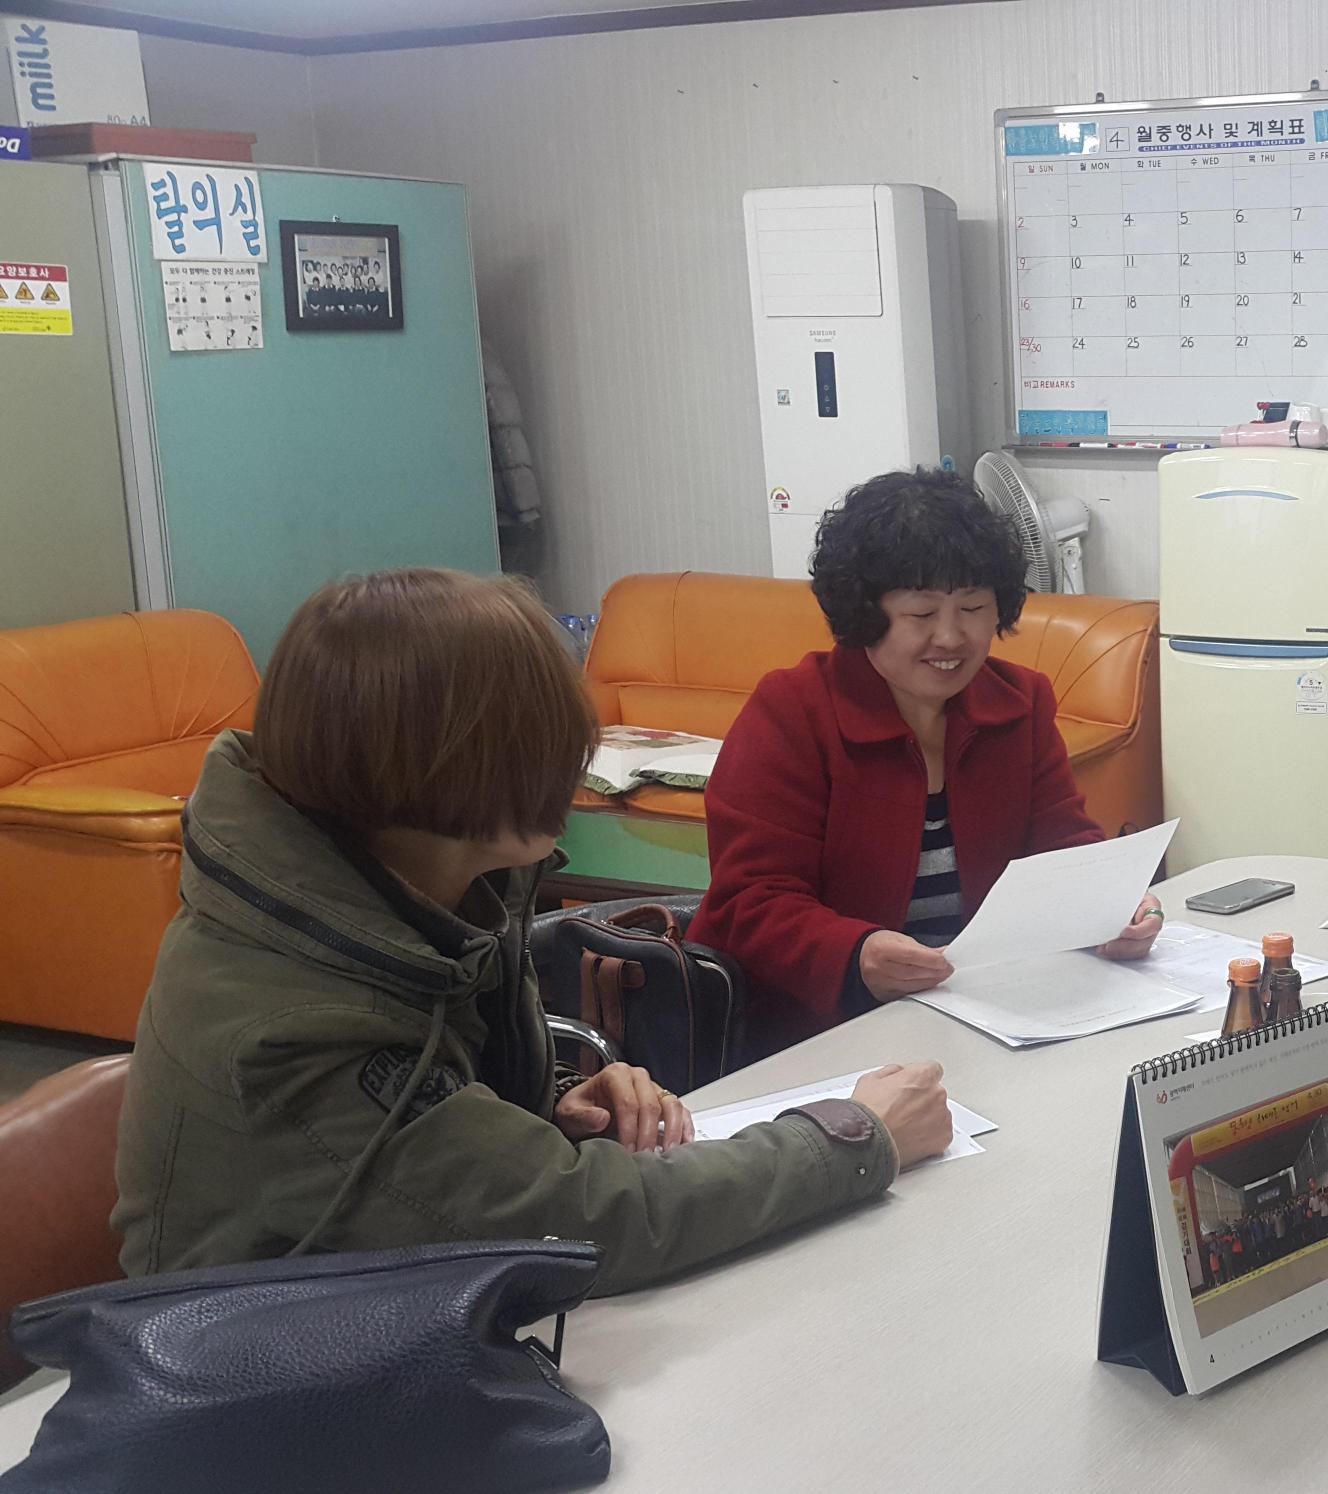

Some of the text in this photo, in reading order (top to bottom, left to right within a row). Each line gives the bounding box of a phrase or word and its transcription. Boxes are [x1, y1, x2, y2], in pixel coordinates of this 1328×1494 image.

[15, 23, 56, 111] miilk
[1109, 131, 1124, 149] 4
[1136, 122, 1214, 142] 월중행사
[1224, 122, 1238, 138] 및
[1247, 118, 1305, 138] 계획표
[1260, 138, 1302, 146] MONTH
[1028, 165, 1035, 173] 일
[1080, 162, 1086, 171] 월
[1091, 162, 1110, 170] MON
[1137, 160, 1144, 168] 화
[1149, 160, 1162, 168] TUE
[1191, 158, 1198, 166] 수
[1202, 157, 1220, 165] WED
[1249, 154, 1256, 162] 목
[1261, 154, 1275, 162] THU
[1308, 152, 1316, 160] 금
[150, 170, 261, 256] 탈의실
[1018, 217, 1025, 229] 2
[1071, 216, 1078, 228] 3
[1124, 214, 1134, 226] 4
[1180, 212, 1189, 225] 5
[1236, 209, 1244, 222] 6
[1294, 208, 1302, 221] 7
[1020, 258, 1026, 270] 9
[1072, 257, 1082, 269] 10
[1126, 256, 1134, 266] 11
[1180, 254, 1190, 266] 12
[1236, 252, 1246, 264] 13
[1294, 251, 1304, 263] 14
[1020, 299, 1030, 310] 16
[1072, 298, 1082, 309] 17
[1127, 296, 1137, 308] 18
[1181, 295, 1190, 308] 19
[1236, 295, 1250, 306] 20
[1292, 292, 1302, 304] 21
[1072, 338, 1085, 349] 24
[1127, 338, 1140, 348] 25
[1181, 337, 1194, 348] 26
[1236, 336, 1248, 346] 27
[1294, 336, 1308, 348] 28
